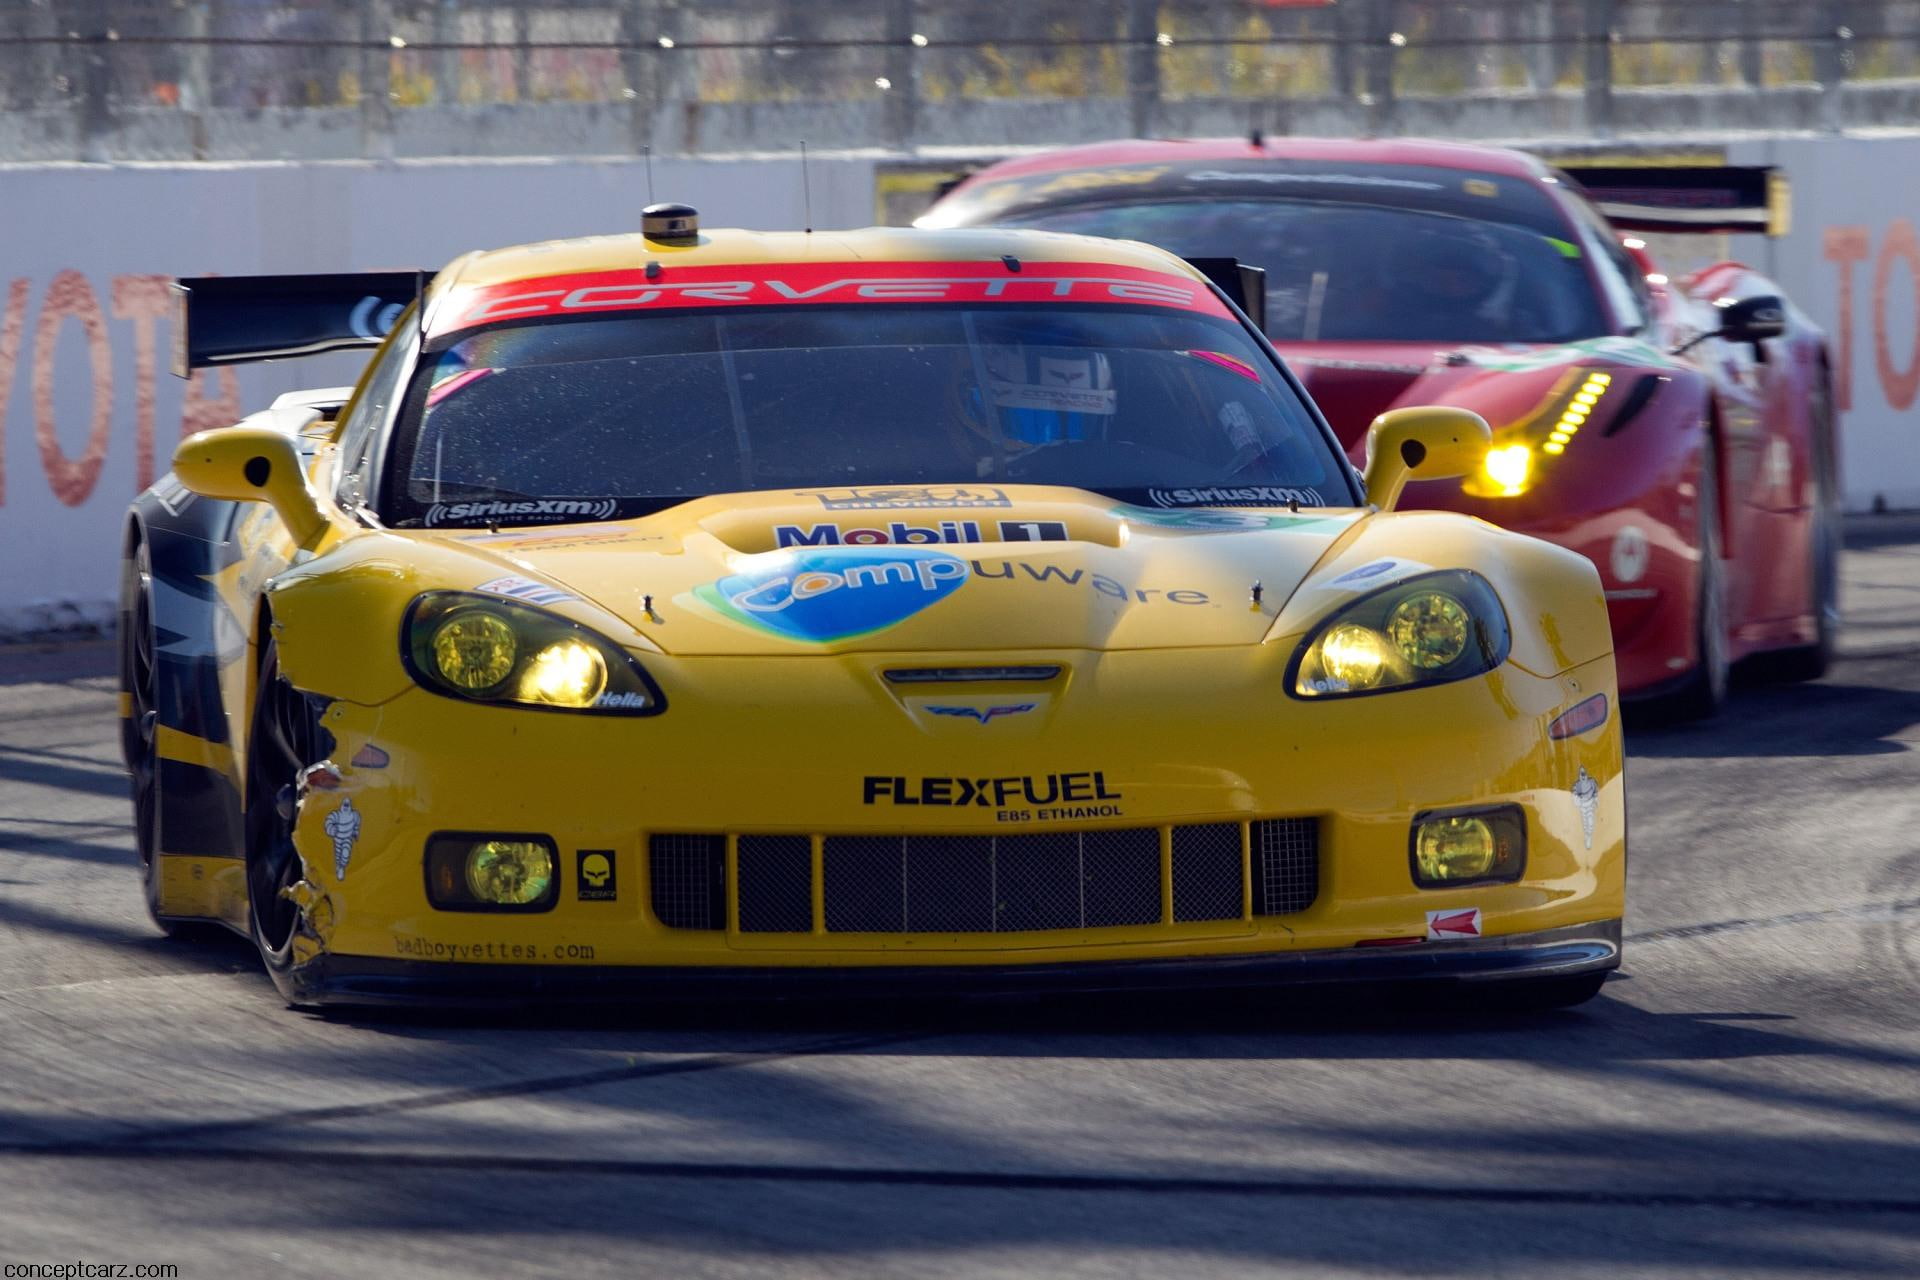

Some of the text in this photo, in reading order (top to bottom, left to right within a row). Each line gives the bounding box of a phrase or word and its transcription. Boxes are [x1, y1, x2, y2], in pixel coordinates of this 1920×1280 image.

[467, 277, 1194, 321] CORVETTE
[831, 500, 1008, 511] CHEVROLET
[774, 520, 982, 547] Mobil
[596, 691, 645, 708] Hella
[863, 771, 1122, 807] FLEXFUEL
[997, 804, 1123, 823] E85 ETHANOL
[394, 935, 595, 960] badboyvettes.com
